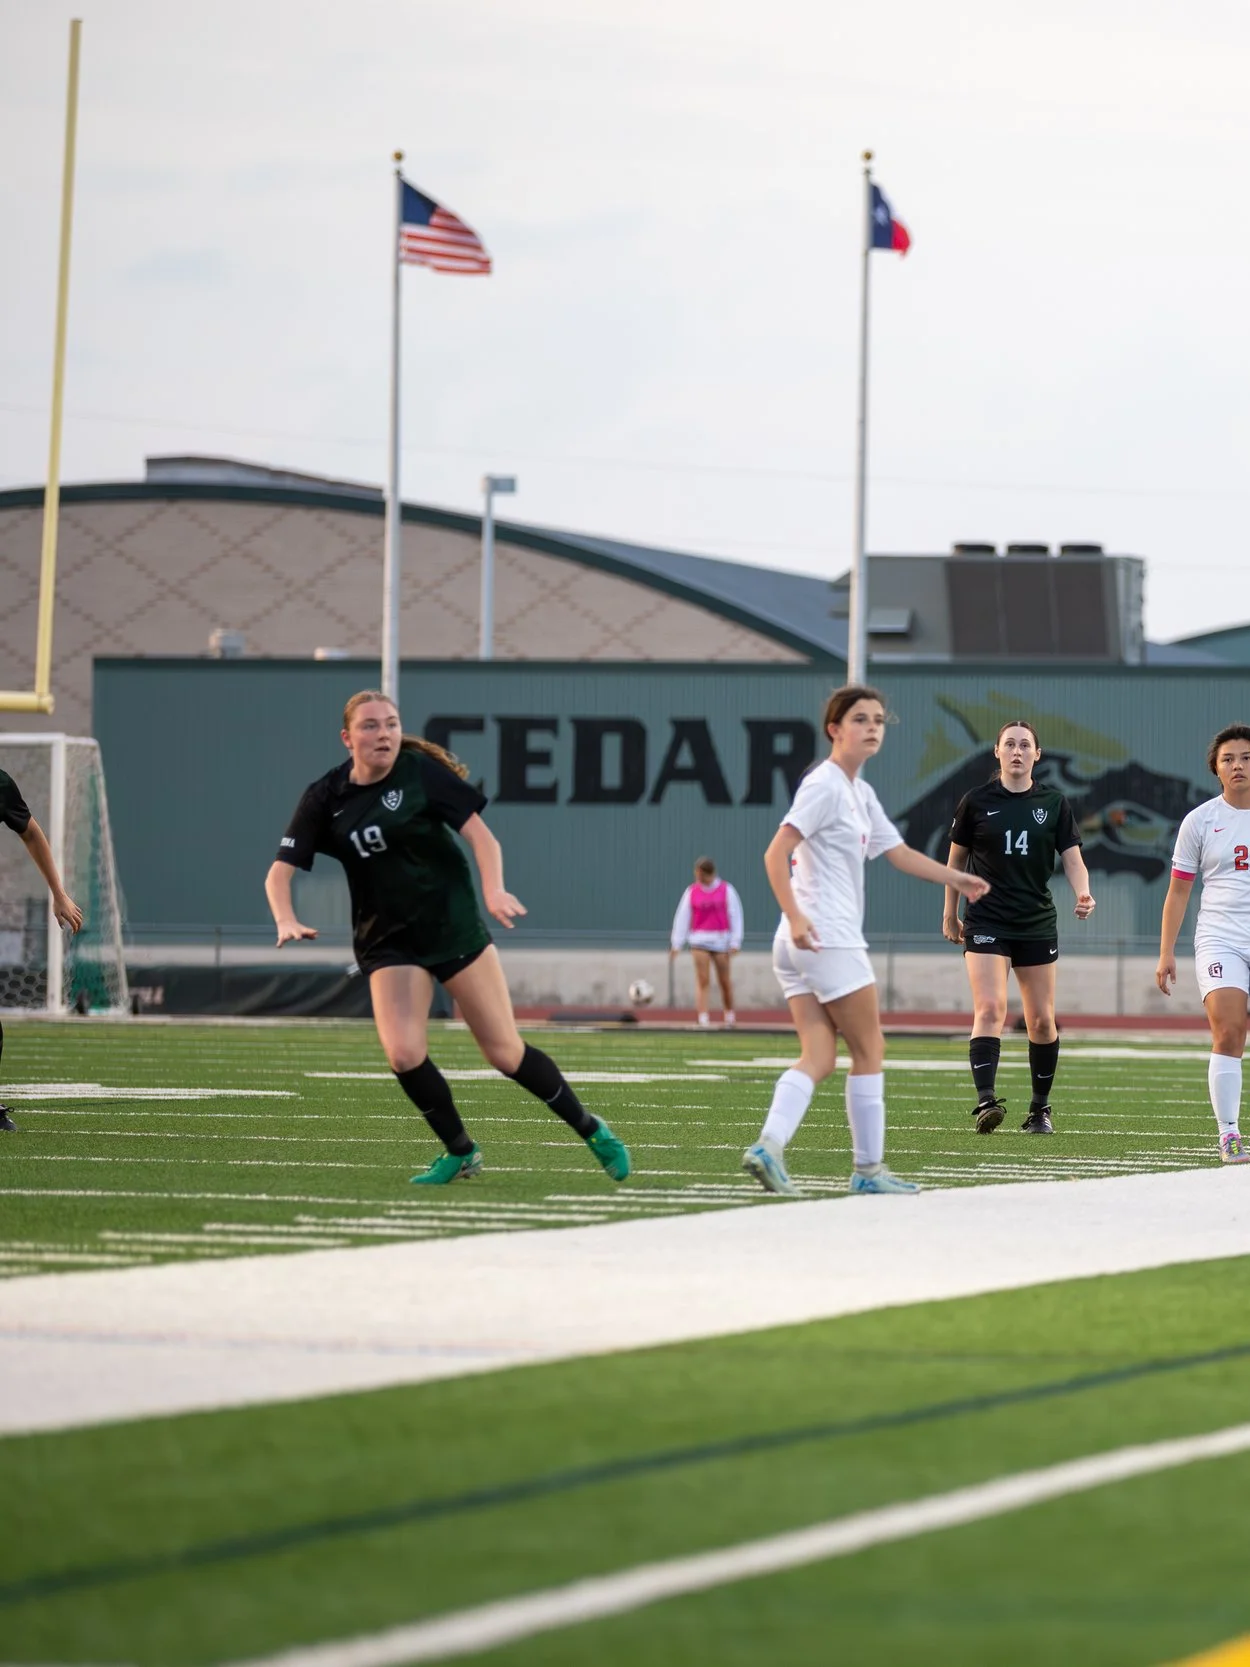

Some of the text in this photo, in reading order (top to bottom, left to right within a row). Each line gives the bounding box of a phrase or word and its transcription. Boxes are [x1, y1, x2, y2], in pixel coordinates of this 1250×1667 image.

[423, 715, 817, 805] CEDAR
[350, 825, 387, 858] 19
[1004, 829, 1029, 856] 14
